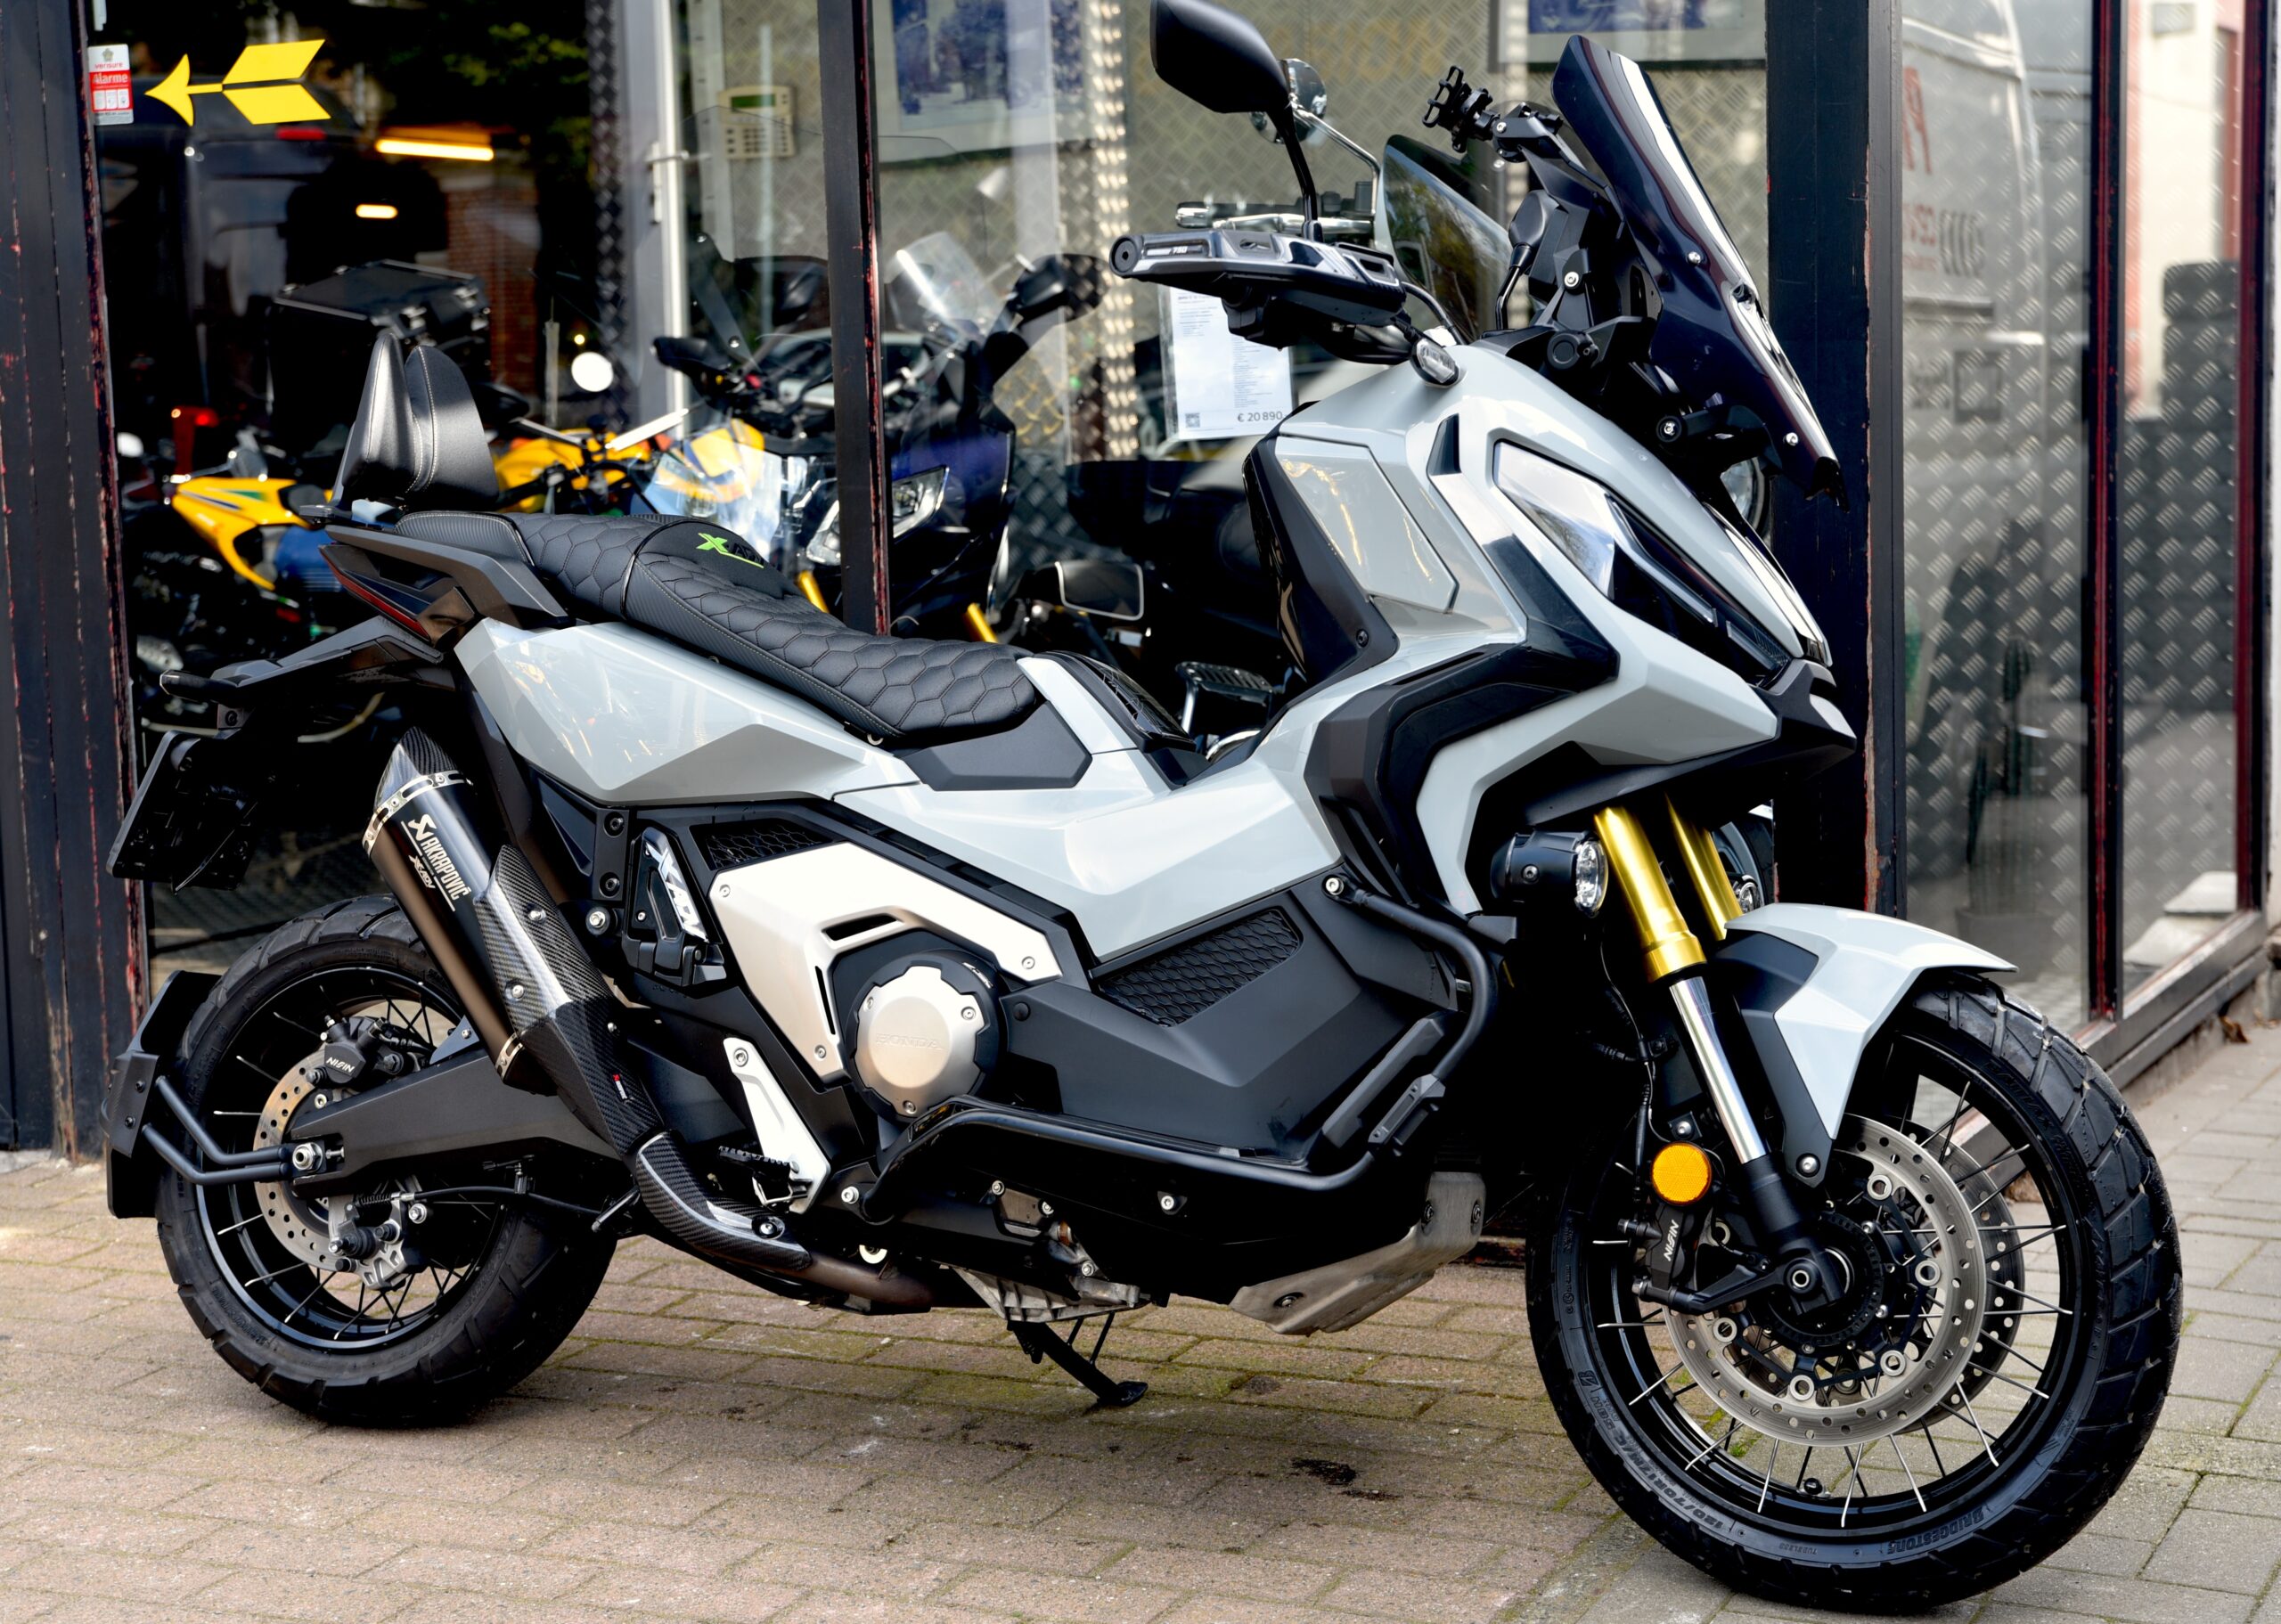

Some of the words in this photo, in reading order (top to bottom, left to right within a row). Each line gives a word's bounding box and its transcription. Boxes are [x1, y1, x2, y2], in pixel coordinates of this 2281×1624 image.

[93, 72, 128, 84] Alarme
[1238, 413, 1245, 422] €
[1247, 412, 1261, 421] 20
[421, 836, 472, 901] AKRAPOVIČ
[1887, 1505, 1984, 1555] BRIDGESTONE
